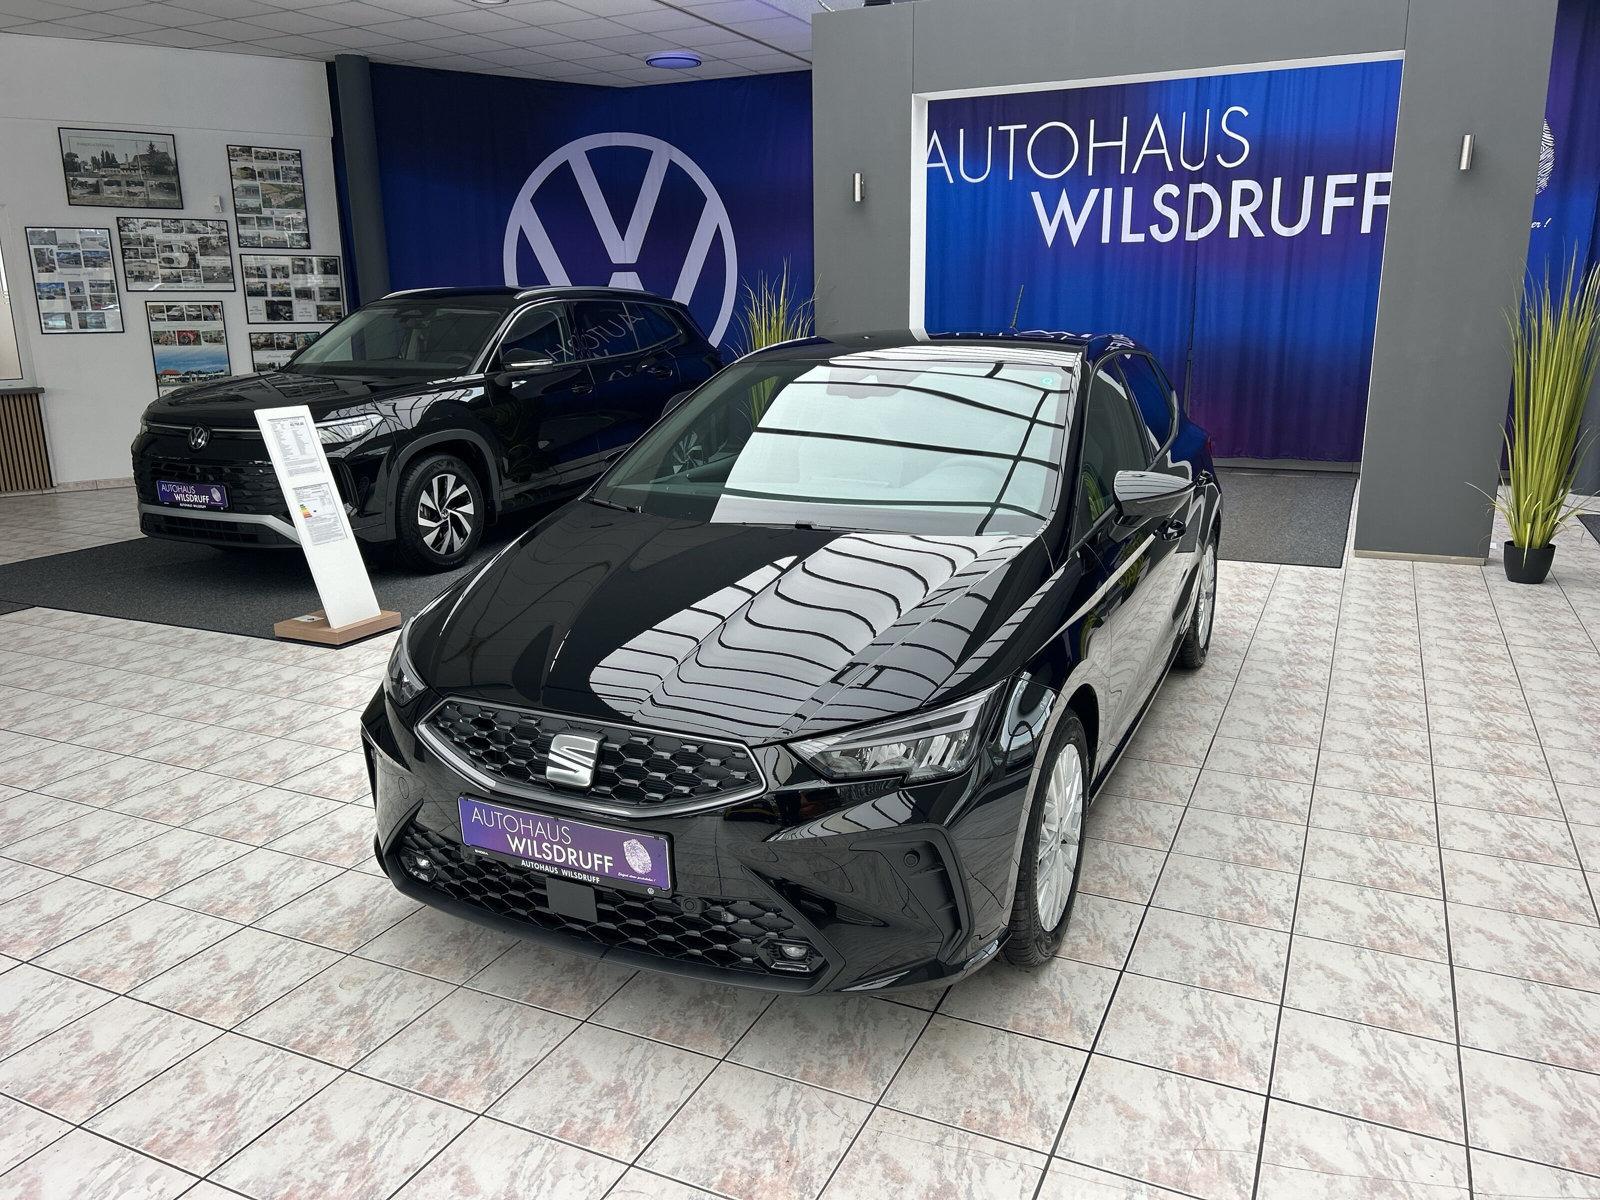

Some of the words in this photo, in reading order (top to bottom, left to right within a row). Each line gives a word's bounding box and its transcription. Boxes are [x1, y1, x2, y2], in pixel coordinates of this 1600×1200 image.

[926, 106, 1250, 184] AUTOHAUS
[1031, 171, 1393, 248] WILSDRUFF
[161, 484, 196, 494] AUTOHAUS
[174, 493, 210, 504] WILSDRUFF
[471, 806, 572, 845] AUTOHAUS
[506, 833, 614, 873] WILSDRUFF
[521, 859, 559, 874] AUTOHAUS
[561, 868, 601, 884] WILSDRUFF
